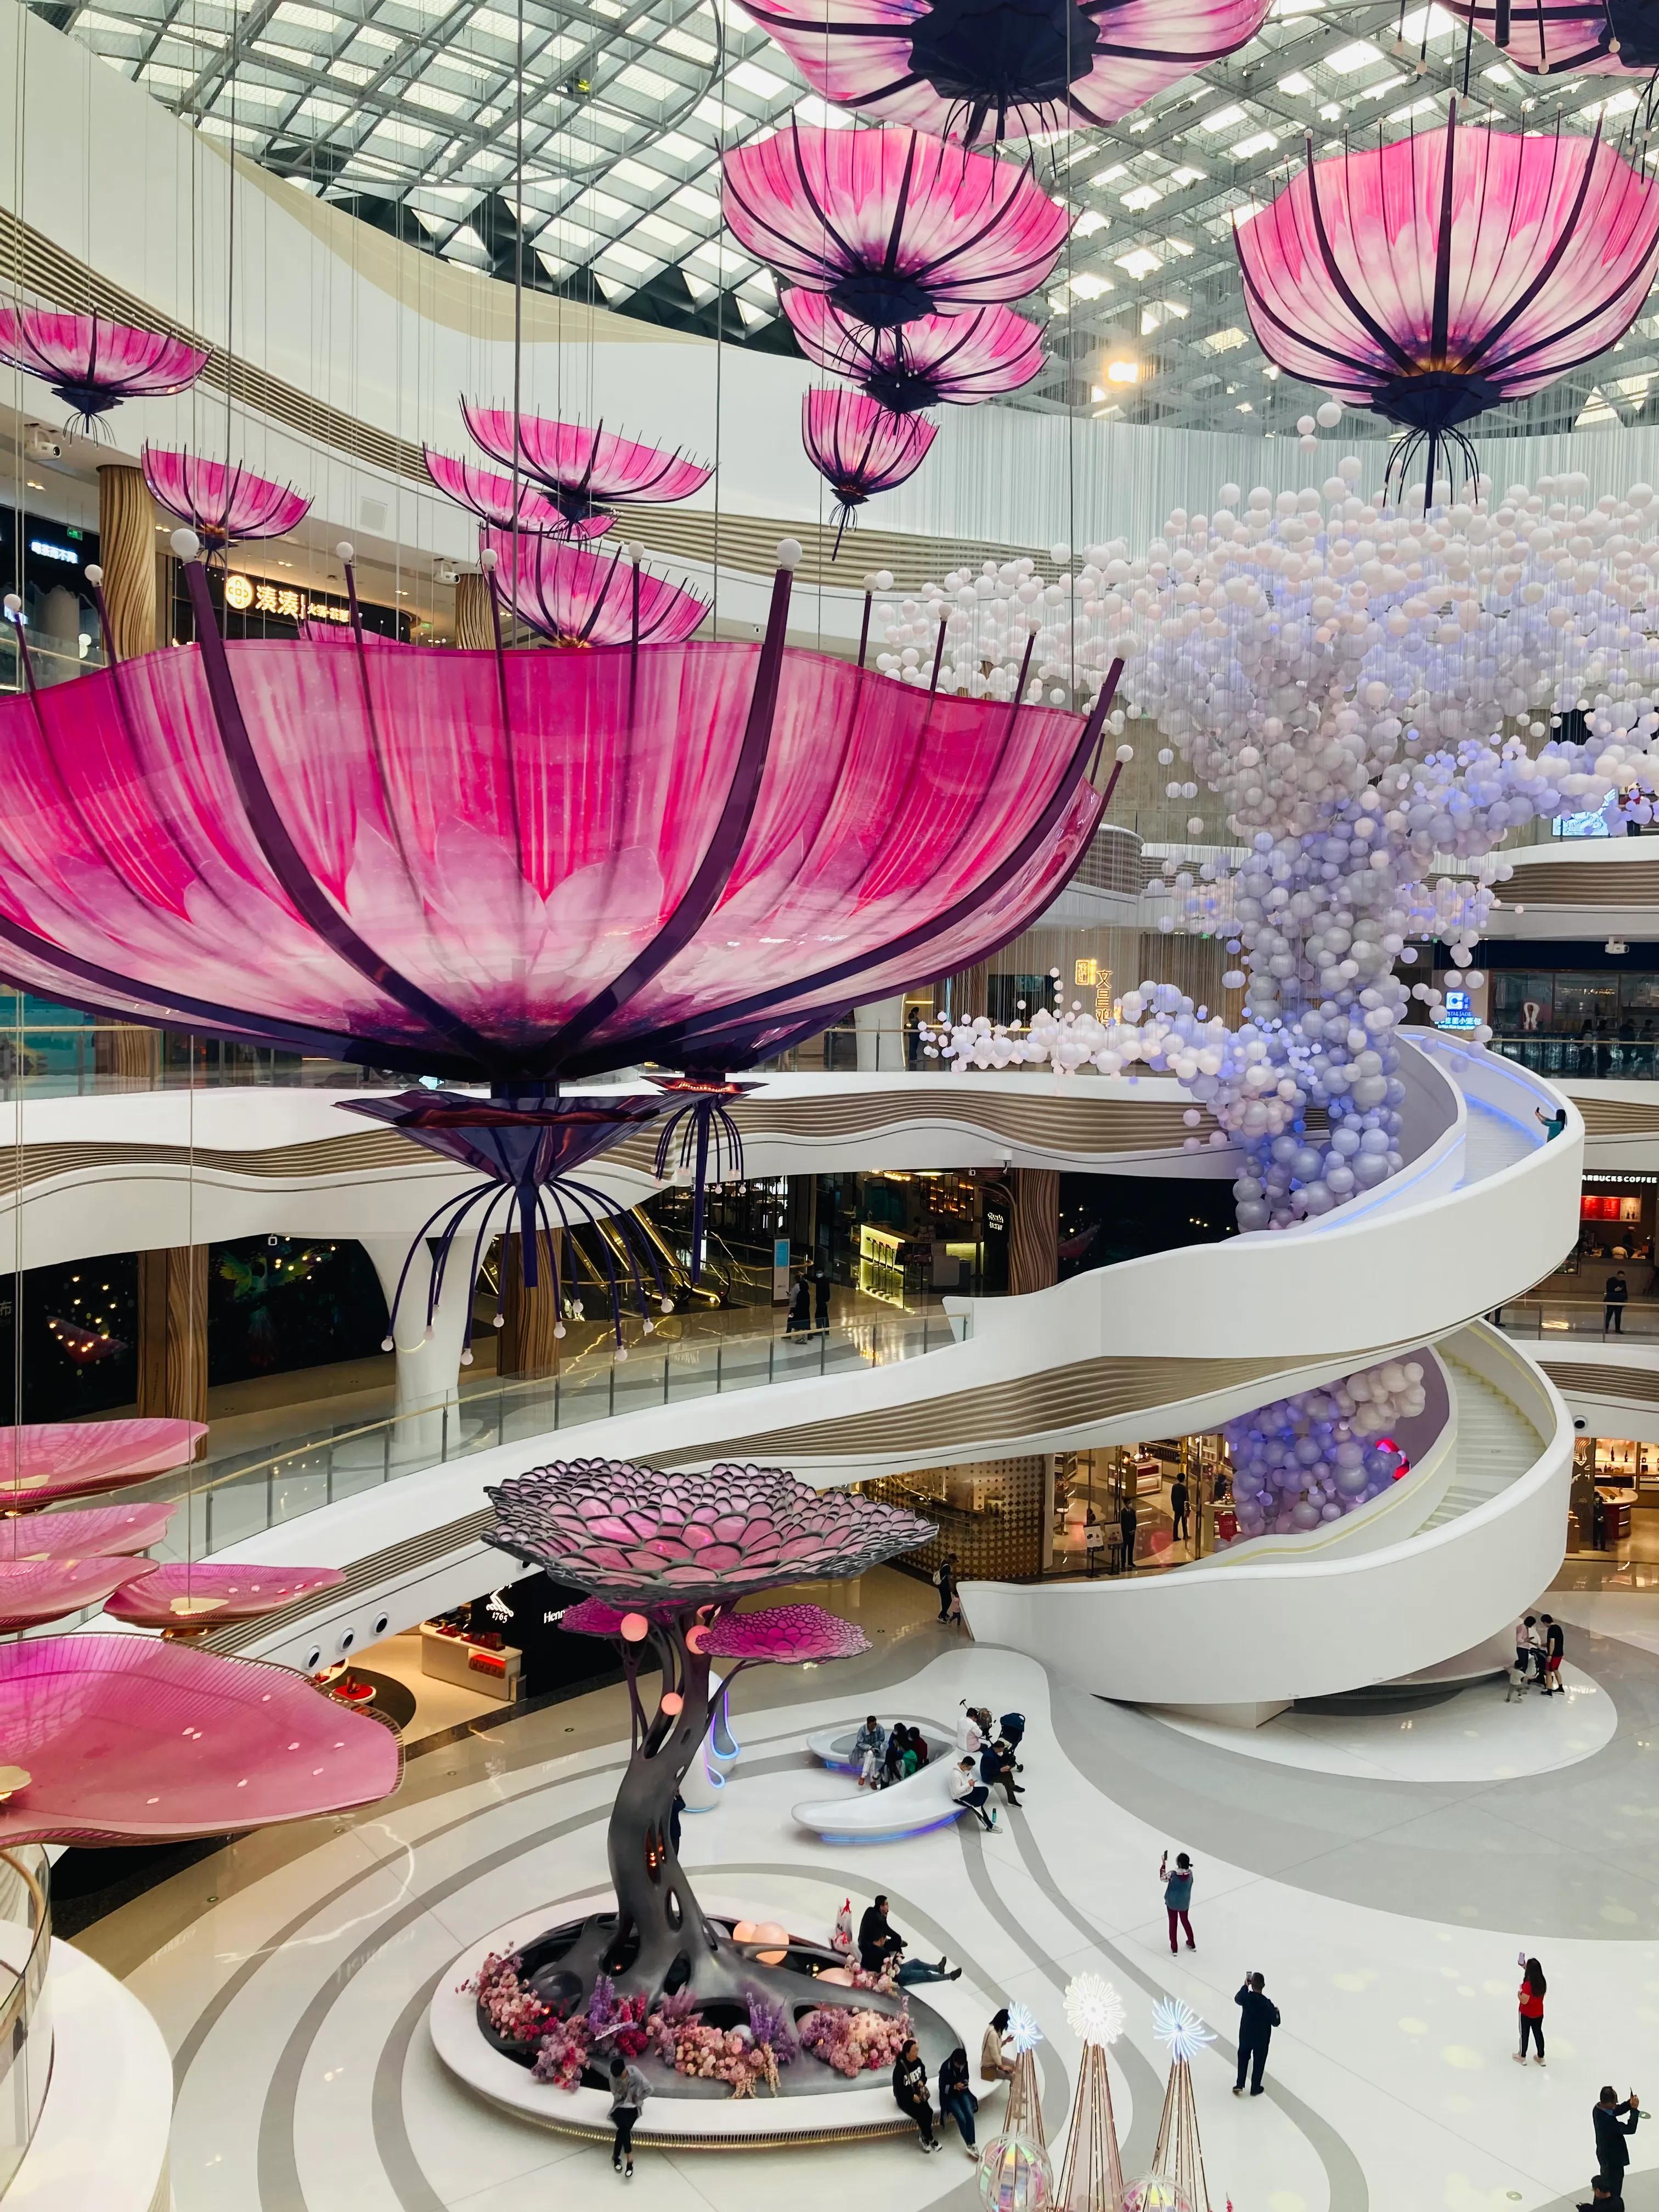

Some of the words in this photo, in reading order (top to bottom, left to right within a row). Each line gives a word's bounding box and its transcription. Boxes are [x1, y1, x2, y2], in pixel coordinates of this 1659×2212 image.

[1096, 969, 1113, 1025] 文昌鸡
[492, 1611, 508, 1623] 1765
